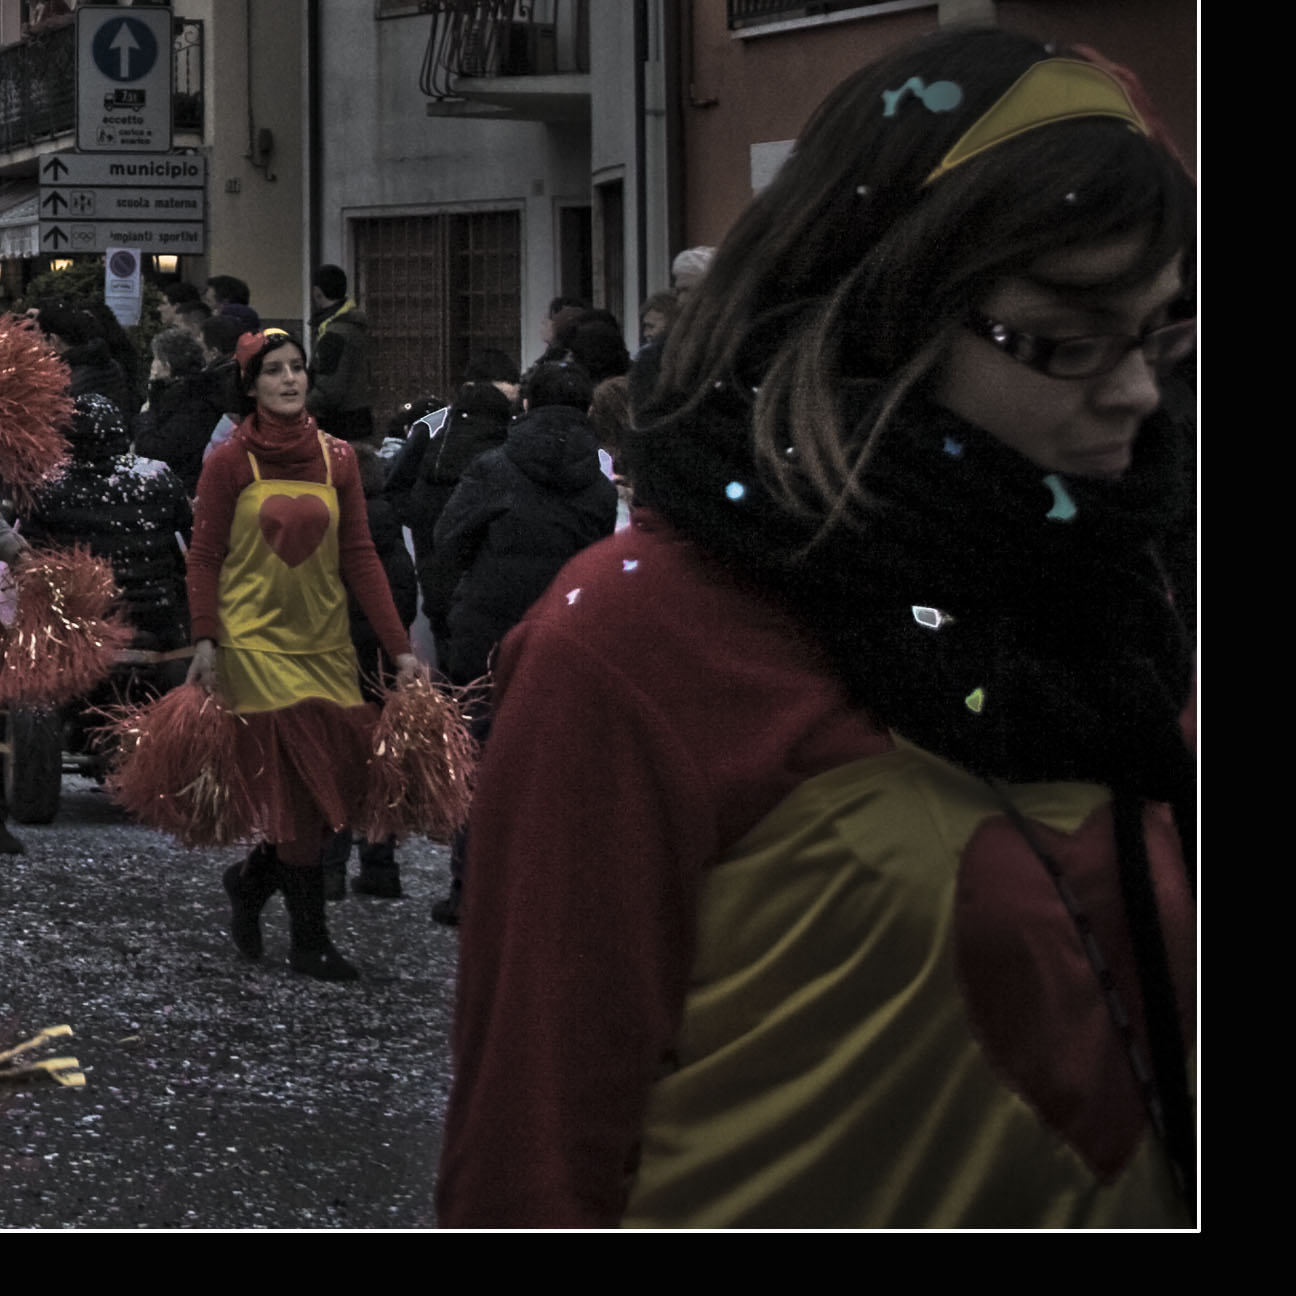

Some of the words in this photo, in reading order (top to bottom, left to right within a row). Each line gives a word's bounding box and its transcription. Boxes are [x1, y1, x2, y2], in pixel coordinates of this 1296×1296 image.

[102, 115, 144, 125] eccetto
[110, 161, 198, 178] municipio
[116, 197, 150, 208] scuola
[154, 197, 197, 208] materna
[110, 230, 153, 244] impianti
[159, 231, 198, 244] sportivi
